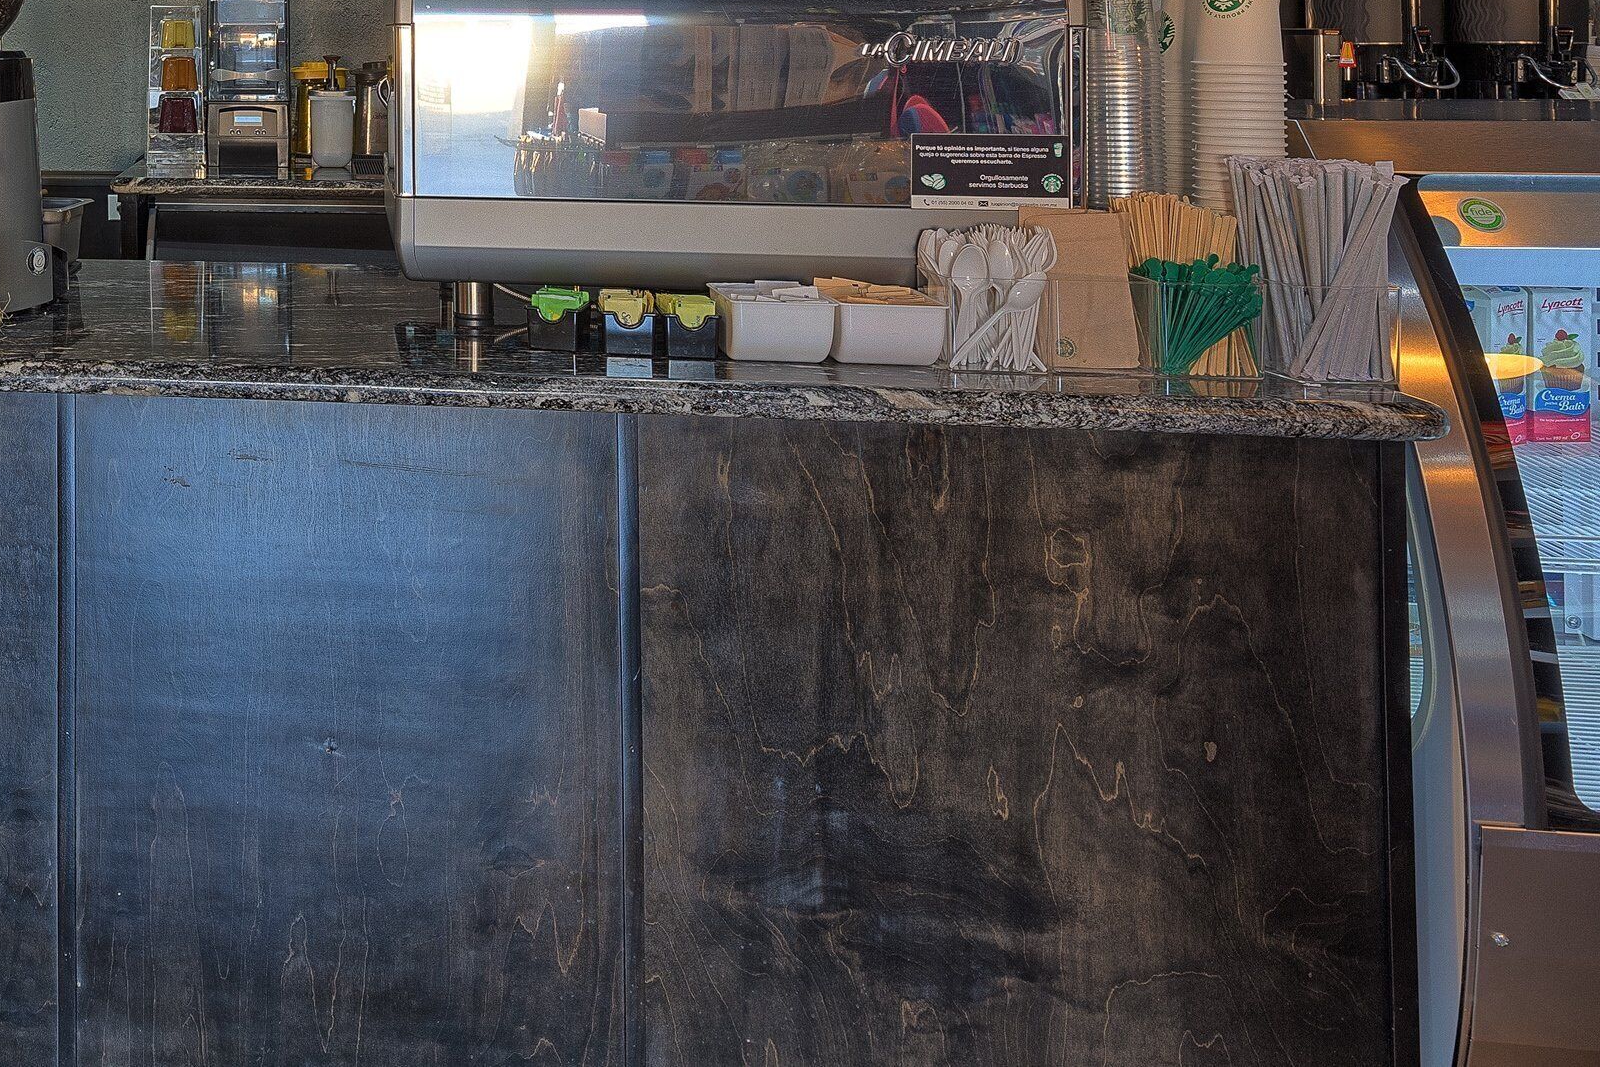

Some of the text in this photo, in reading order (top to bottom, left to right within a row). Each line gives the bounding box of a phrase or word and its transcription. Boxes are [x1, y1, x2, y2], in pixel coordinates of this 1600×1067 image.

[980, 174, 1028, 182] Orgullosamente
[1469, 207, 1492, 215] fide
[1498, 300, 1523, 315] Lyncott
[1541, 297, 1583, 312] Lyncott
[1541, 389, 1576, 402] Crema
[1558, 401, 1586, 411] Batir
